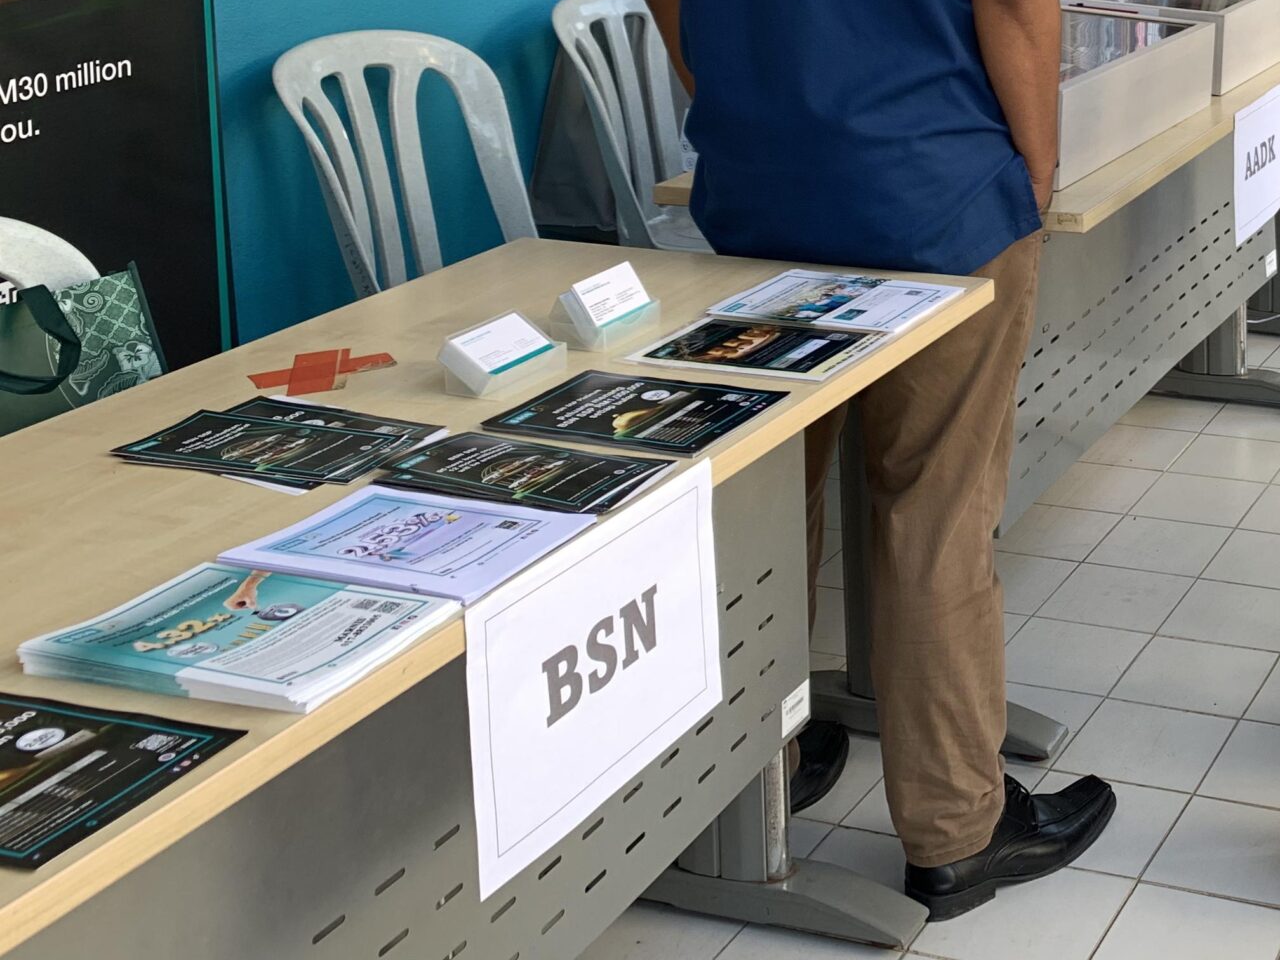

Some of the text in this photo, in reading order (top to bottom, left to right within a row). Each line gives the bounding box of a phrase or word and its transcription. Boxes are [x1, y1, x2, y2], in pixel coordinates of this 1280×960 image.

[56, 59, 132, 93] million
[0, 119, 40, 143] ou.
[1244, 134, 1276, 181] AADK
[541, 583, 658, 728] BSN
